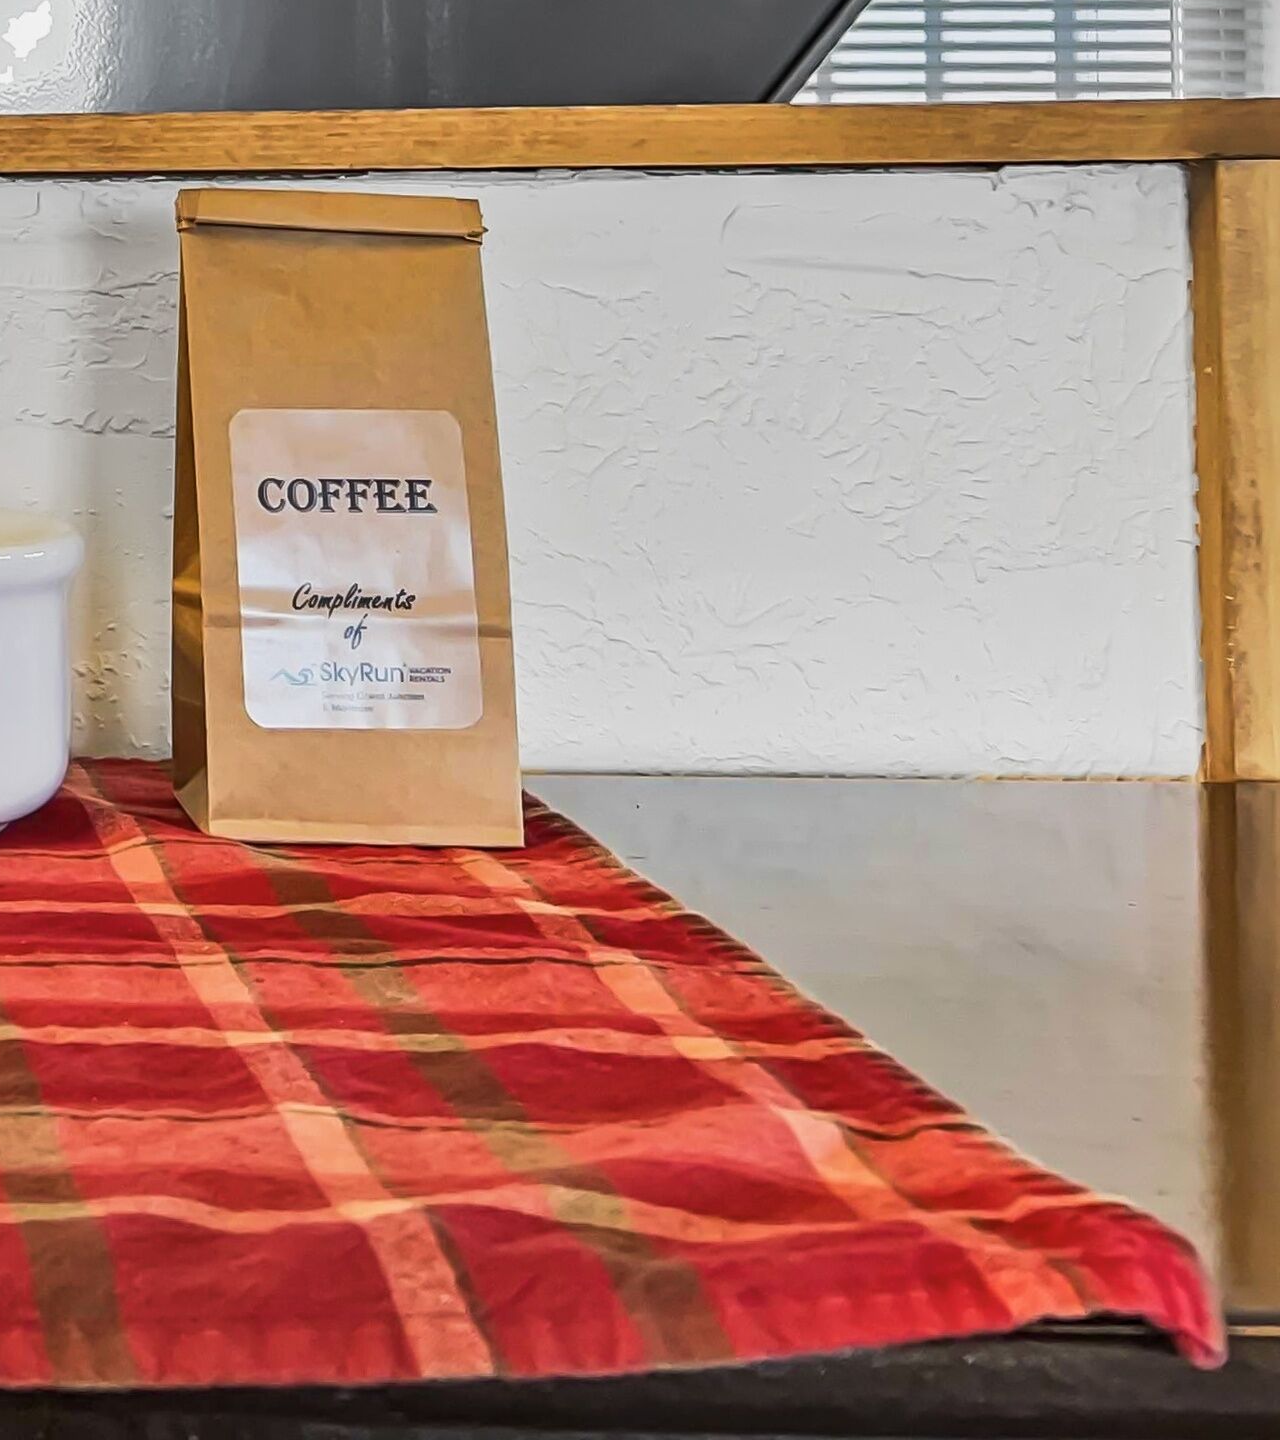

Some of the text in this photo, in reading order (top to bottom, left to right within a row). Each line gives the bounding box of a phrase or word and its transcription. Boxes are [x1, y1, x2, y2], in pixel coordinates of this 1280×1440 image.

[257, 477, 439, 514] COFFEE
[292, 582, 416, 619] Compliments
[343, 613, 369, 651] of
[319, 661, 405, 687] SkyRun
